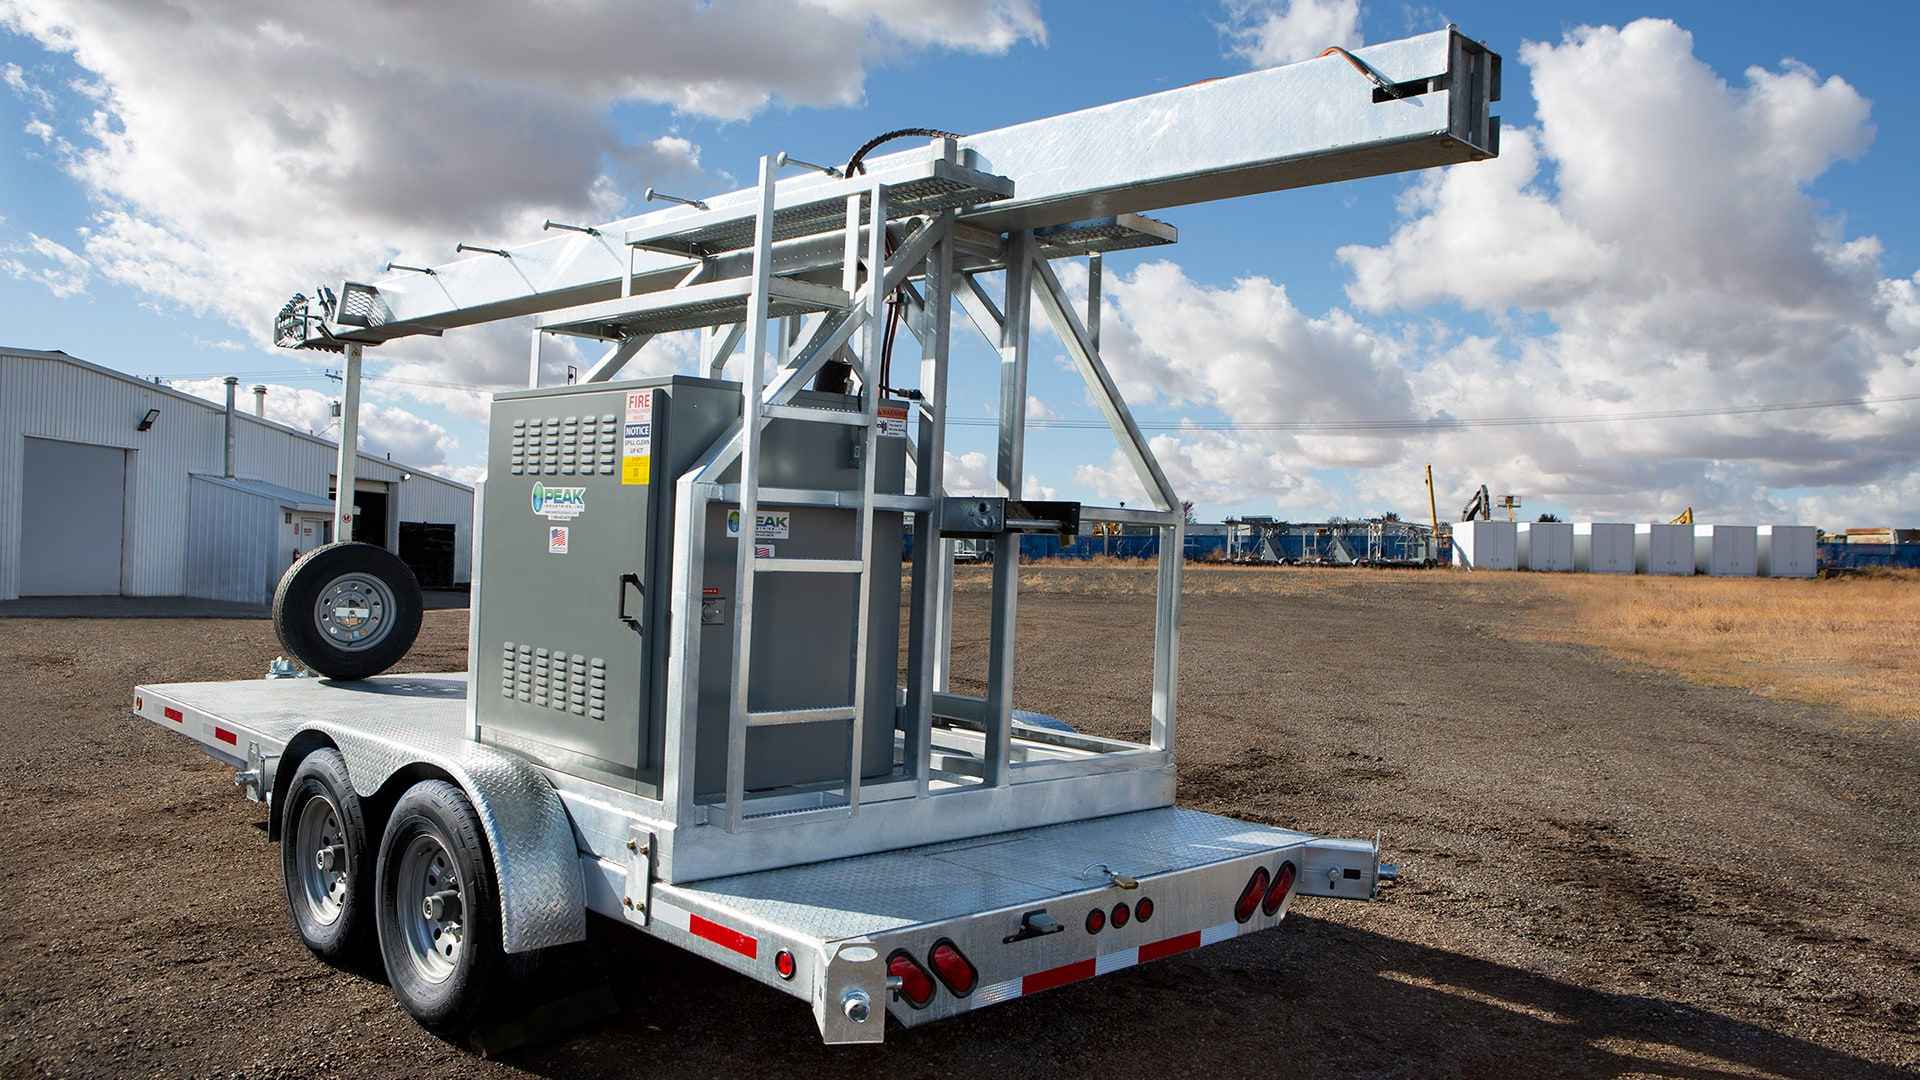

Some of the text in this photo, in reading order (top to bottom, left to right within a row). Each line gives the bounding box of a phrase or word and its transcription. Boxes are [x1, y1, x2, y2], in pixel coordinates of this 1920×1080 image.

[629, 394, 650, 408] FIRE
[626, 426, 649, 436] NOTICE
[544, 488, 584, 504] PEAK
[756, 516, 787, 527] EAK
